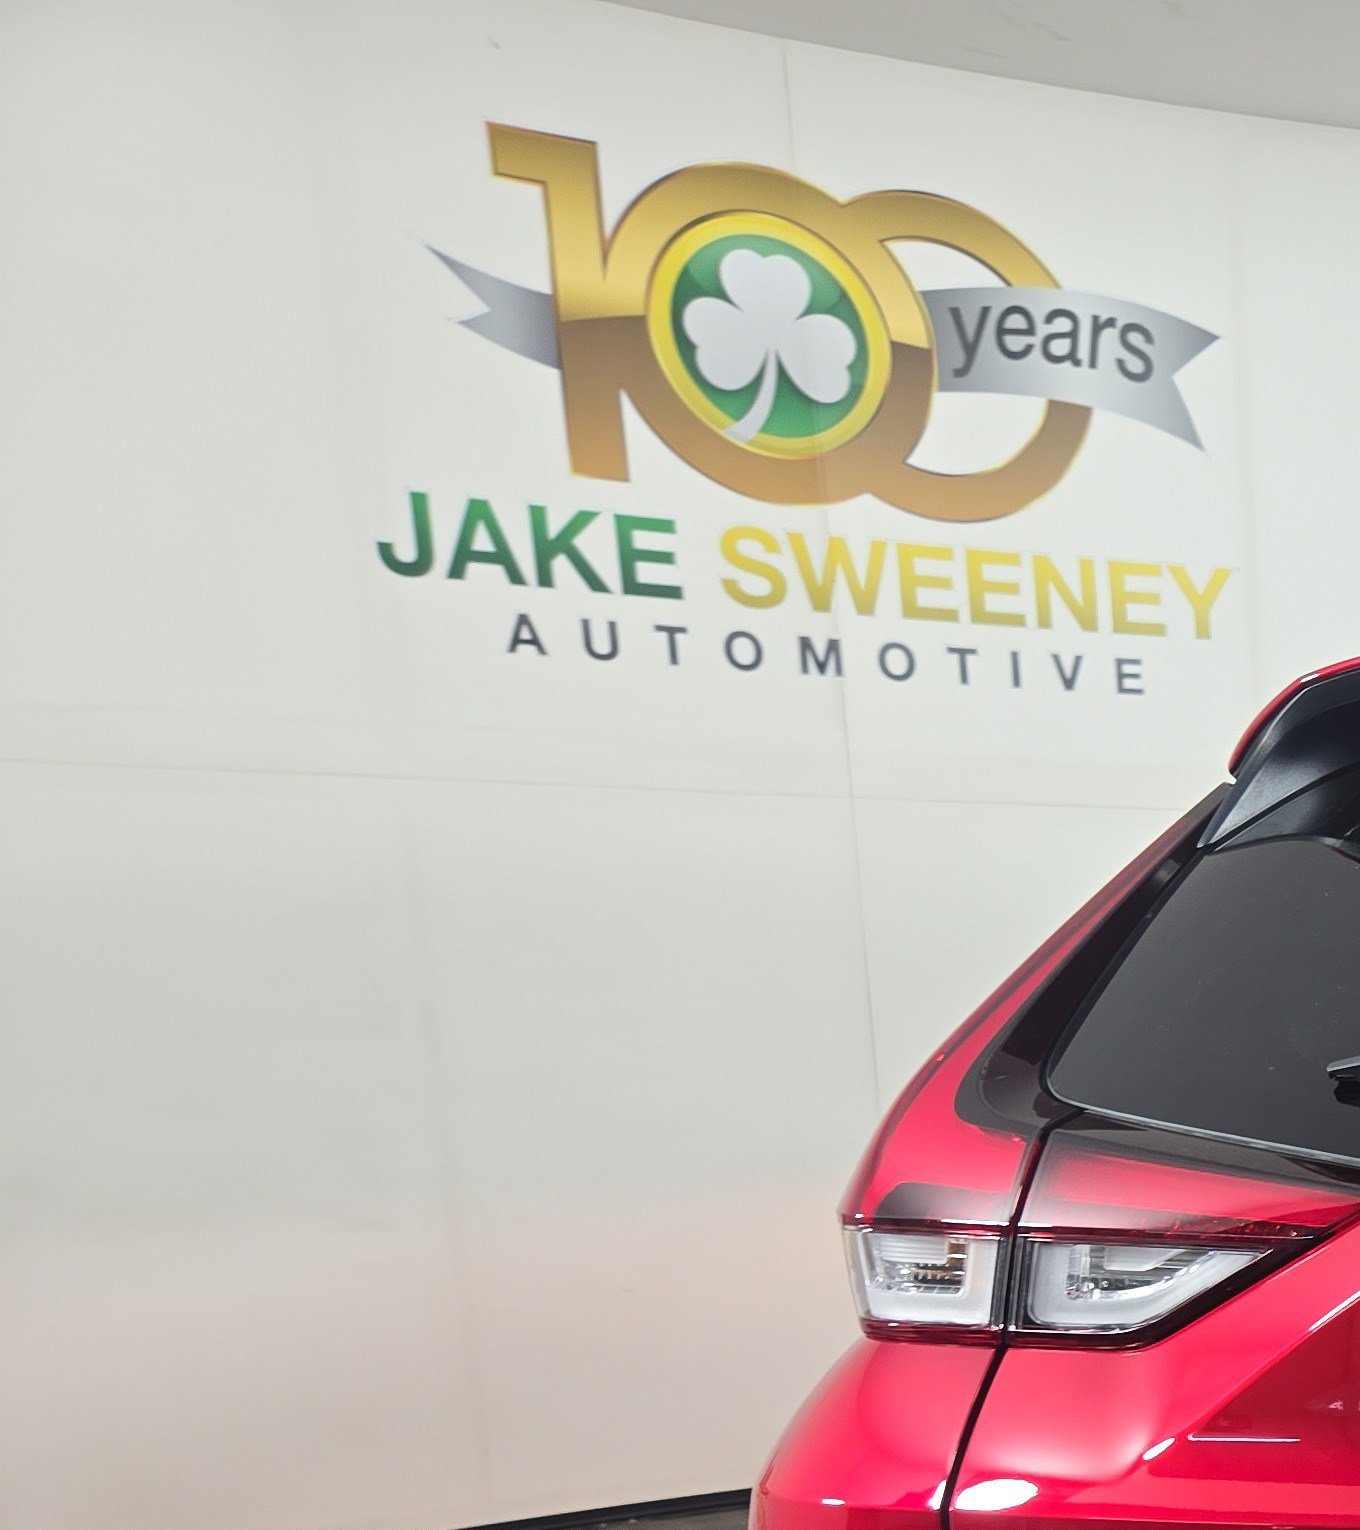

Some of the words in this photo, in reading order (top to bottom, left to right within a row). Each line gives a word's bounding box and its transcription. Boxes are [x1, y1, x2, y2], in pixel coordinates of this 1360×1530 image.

[485, 121, 1093, 522] 100
[947, 302, 1156, 384] years
[376, 490, 685, 599] JAKE
[718, 525, 1234, 640] SWEENEY
[507, 612, 1147, 696] AUTOMOTIVE
